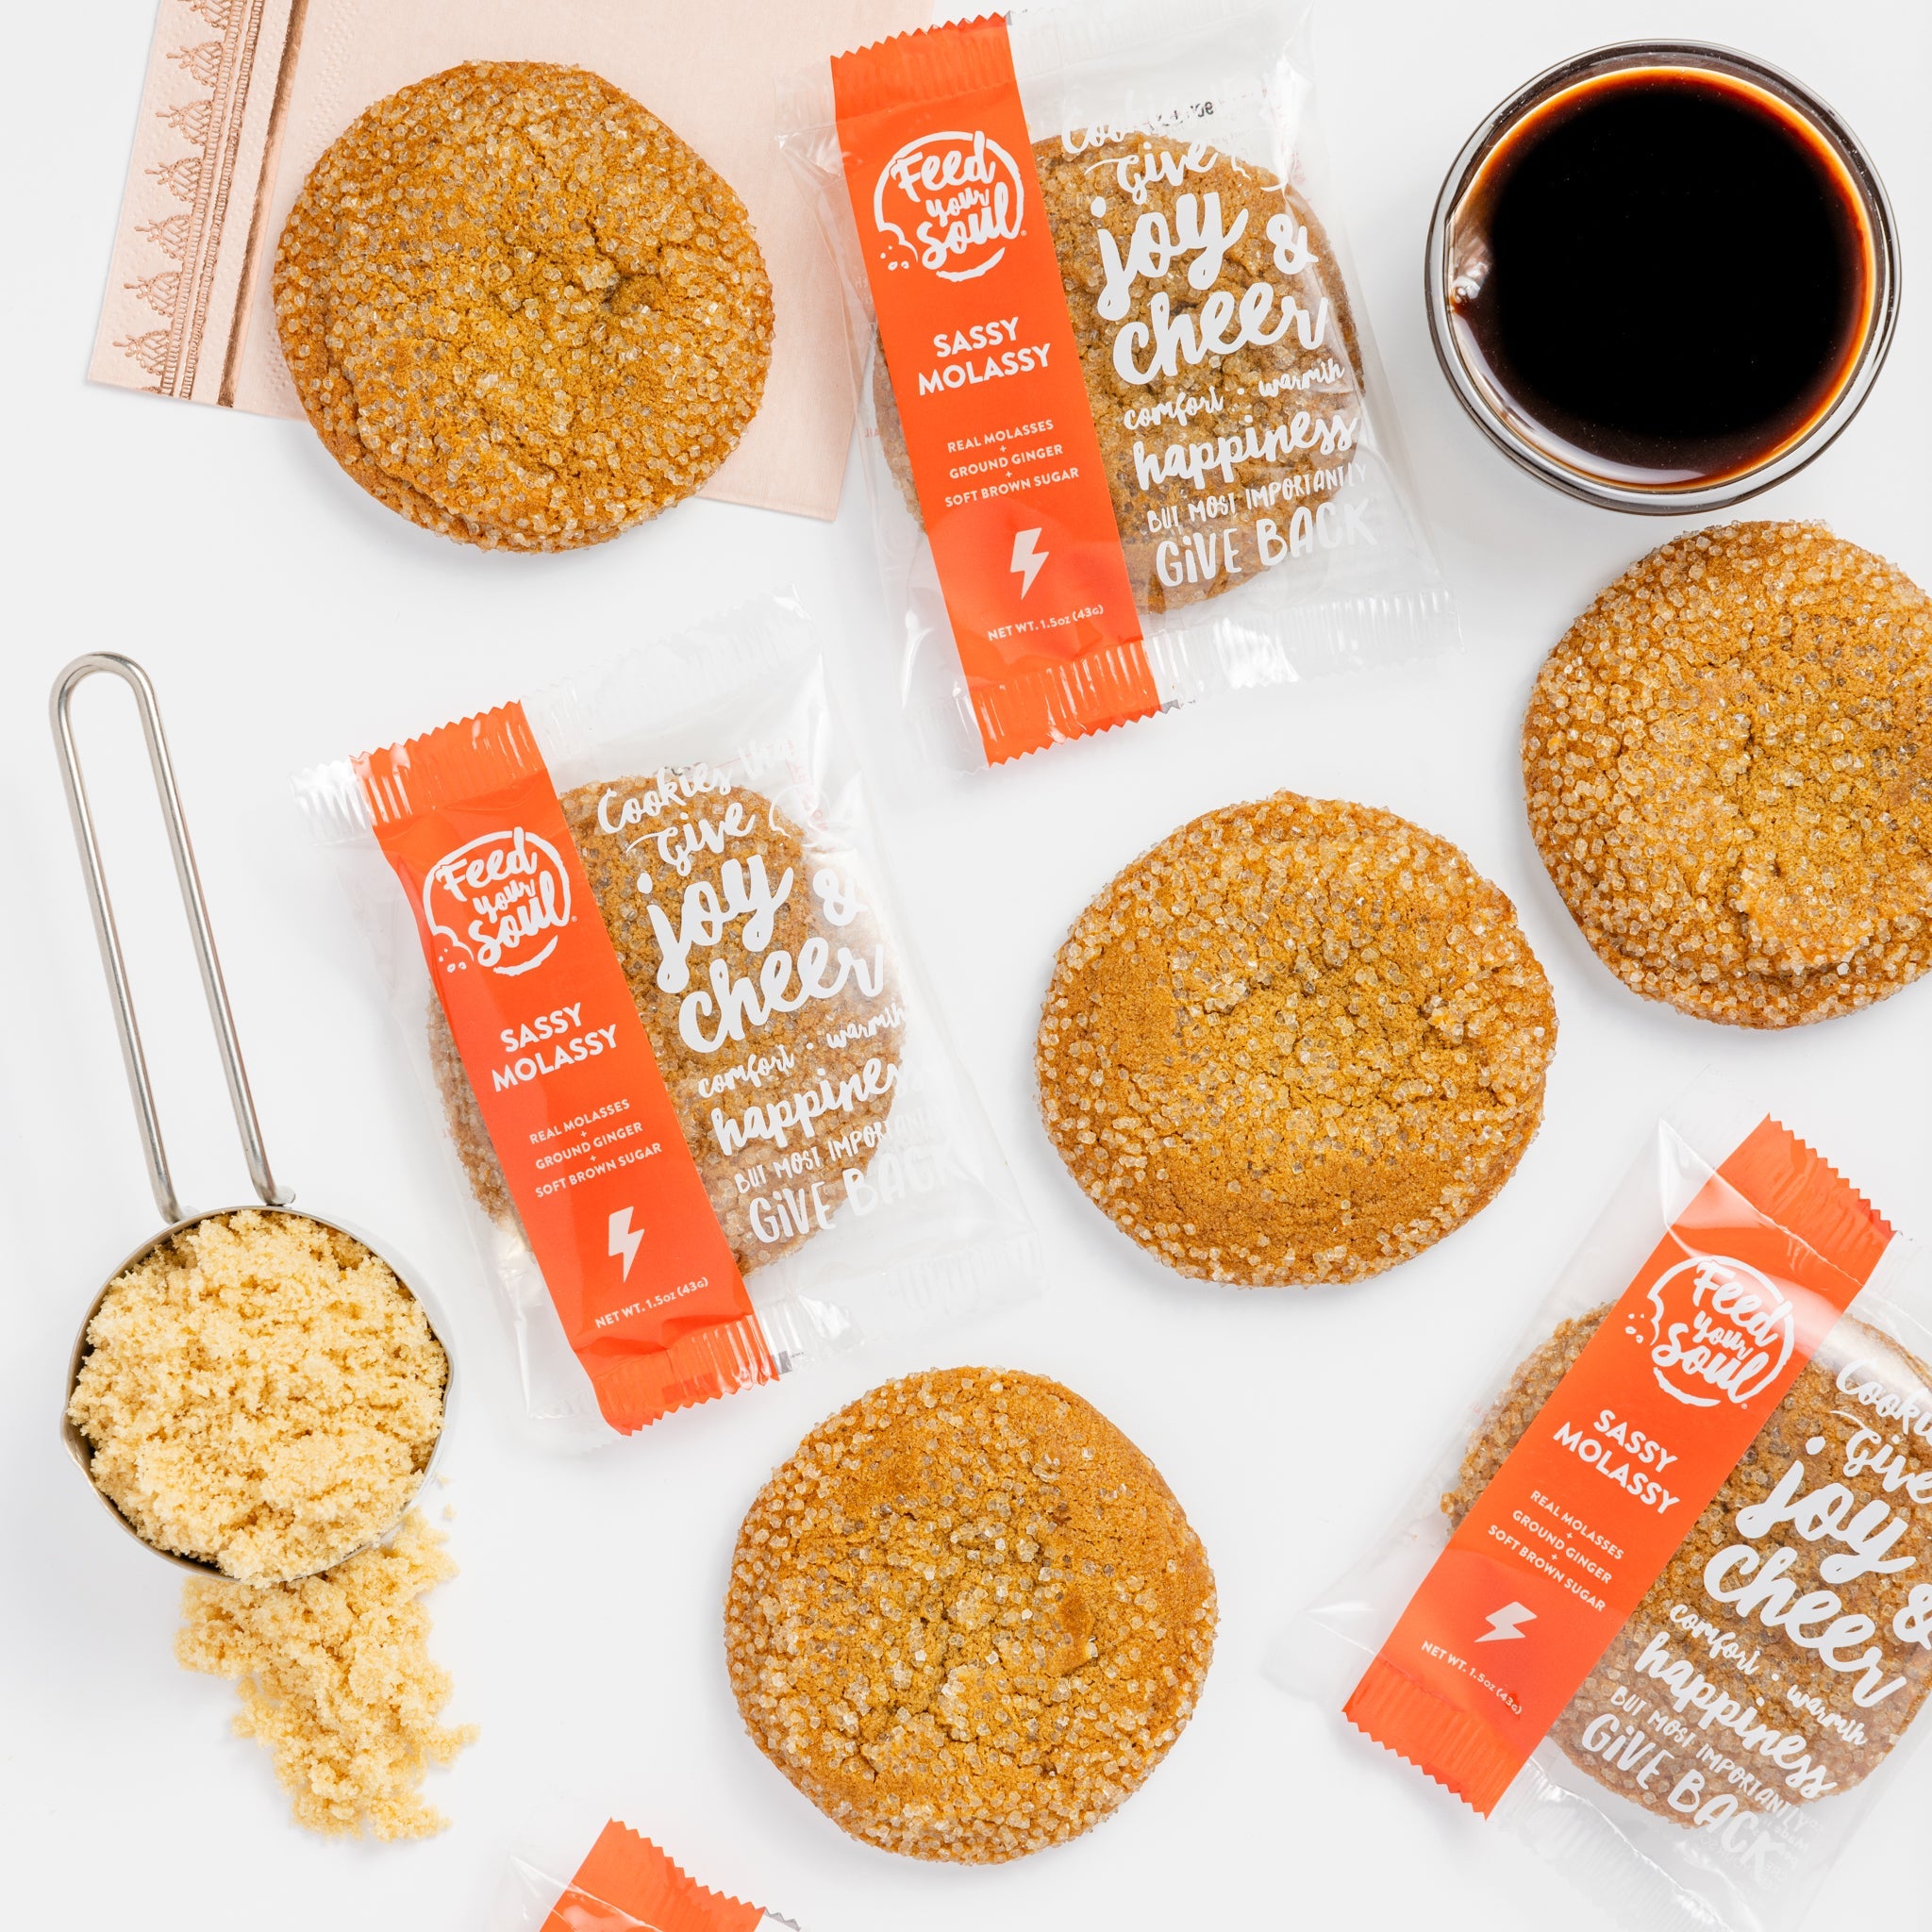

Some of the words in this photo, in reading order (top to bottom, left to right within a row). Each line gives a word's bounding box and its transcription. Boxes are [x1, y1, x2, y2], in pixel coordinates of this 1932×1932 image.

[891, 130, 995, 202] Feed
[1084, 142, 1219, 206] Give
[916, 181, 1020, 270] Soul
[925, 187, 990, 227] your
[1091, 192, 1249, 322] joy
[1266, 213, 1319, 275] &
[918, 343, 1051, 396] MOLASSY
[933, 317, 1019, 358] SASSY
[1113, 282, 1328, 385] cheer
[1124, 385, 1224, 431] comfort
[1257, 358, 1345, 398] warmth
[947, 436, 982, 453] REAL
[984, 419, 1055, 445] MOLASSES
[949, 457, 1009, 480] GROUND
[1011, 443, 1063, 466] GINGER
[1132, 411, 1358, 491] happiness
[944, 490, 978, 508] SOFT
[980, 475, 1032, 500] BROWN
[1033, 467, 1079, 488] SUGAR
[1146, 505, 1182, 534] BUT
[1188, 492, 1237, 523] MOST
[1245, 463, 1367, 510] IMPORTANTLY
[1256, 498, 1378, 566] BACK
[988, 624, 1013, 641] NET
[1015, 620, 1039, 635] WT.
[597, 761, 733, 835] Cookies
[435, 826, 538, 902] Feed
[625, 802, 756, 877] Give
[468, 870, 570, 968] Soul
[473, 878, 537, 924] your
[637, 854, 794, 994] joy
[812, 867, 867, 926] &
[500, 1002, 582, 1052] SASSY
[678, 937, 884, 1053] cheer
[491, 1024, 617, 1092] MOLASSY
[698, 1043, 795, 1099] comfort
[825, 1001, 906, 1049] warmth
[529, 1126, 562, 1145] REAL
[563, 1098, 631, 1131] MOLASSES
[535, 1141, 591, 1170] GROUND
[592, 1122, 643, 1148] GINGER
[535, 1177, 567, 1198] SOFT
[568, 1159, 618, 1187] BROWN
[618, 1142, 662, 1168] SUGAR
[734, 1163, 767, 1194] BUT
[773, 1146, 822, 1179] MOST
[594, 1310, 620, 1329] NET
[621, 1303, 646, 1319] WT.
[1692, 1261, 1792, 1347] Feed
[1692, 1310, 1754, 1360] your
[1651, 1323, 1770, 1404] Soul
[1552, 1421, 1680, 1515] MOLASSY
[1593, 1409, 1678, 1473] SASSY
[1829, 1410, 1932, 1505] Give
[1512, 1509, 1566, 1551] GROUND
[1565, 1546, 1612, 1585] GINGER
[1530, 1490, 1559, 1518] REAL
[1560, 1511, 1624, 1560] MOLASSES
[1736, 1436, 1917, 1584] joy
[1892, 1583, 1932, 1651] &
[1487, 1524, 1521, 1551] SOFT
[1518, 1545, 1565, 1583] BROWN
[1563, 1577, 1606, 1612] SUGAR
[1421, 1640, 1448, 1661] NET
[1447, 1653, 1468, 1673] WT.
[1704, 1544, 1907, 1707] cheer
[1669, 1604, 1761, 1675] comfort
[1786, 1684, 1868, 1746] warmth
[1634, 1631, 1838, 1799] happiness
[1609, 1685, 1649, 1717] BUT
[1647, 1707, 1698, 1748] MOST
[1695, 1742, 1811, 1832] IMPORTANTLY
[1667, 1769, 1786, 1885] BACK
